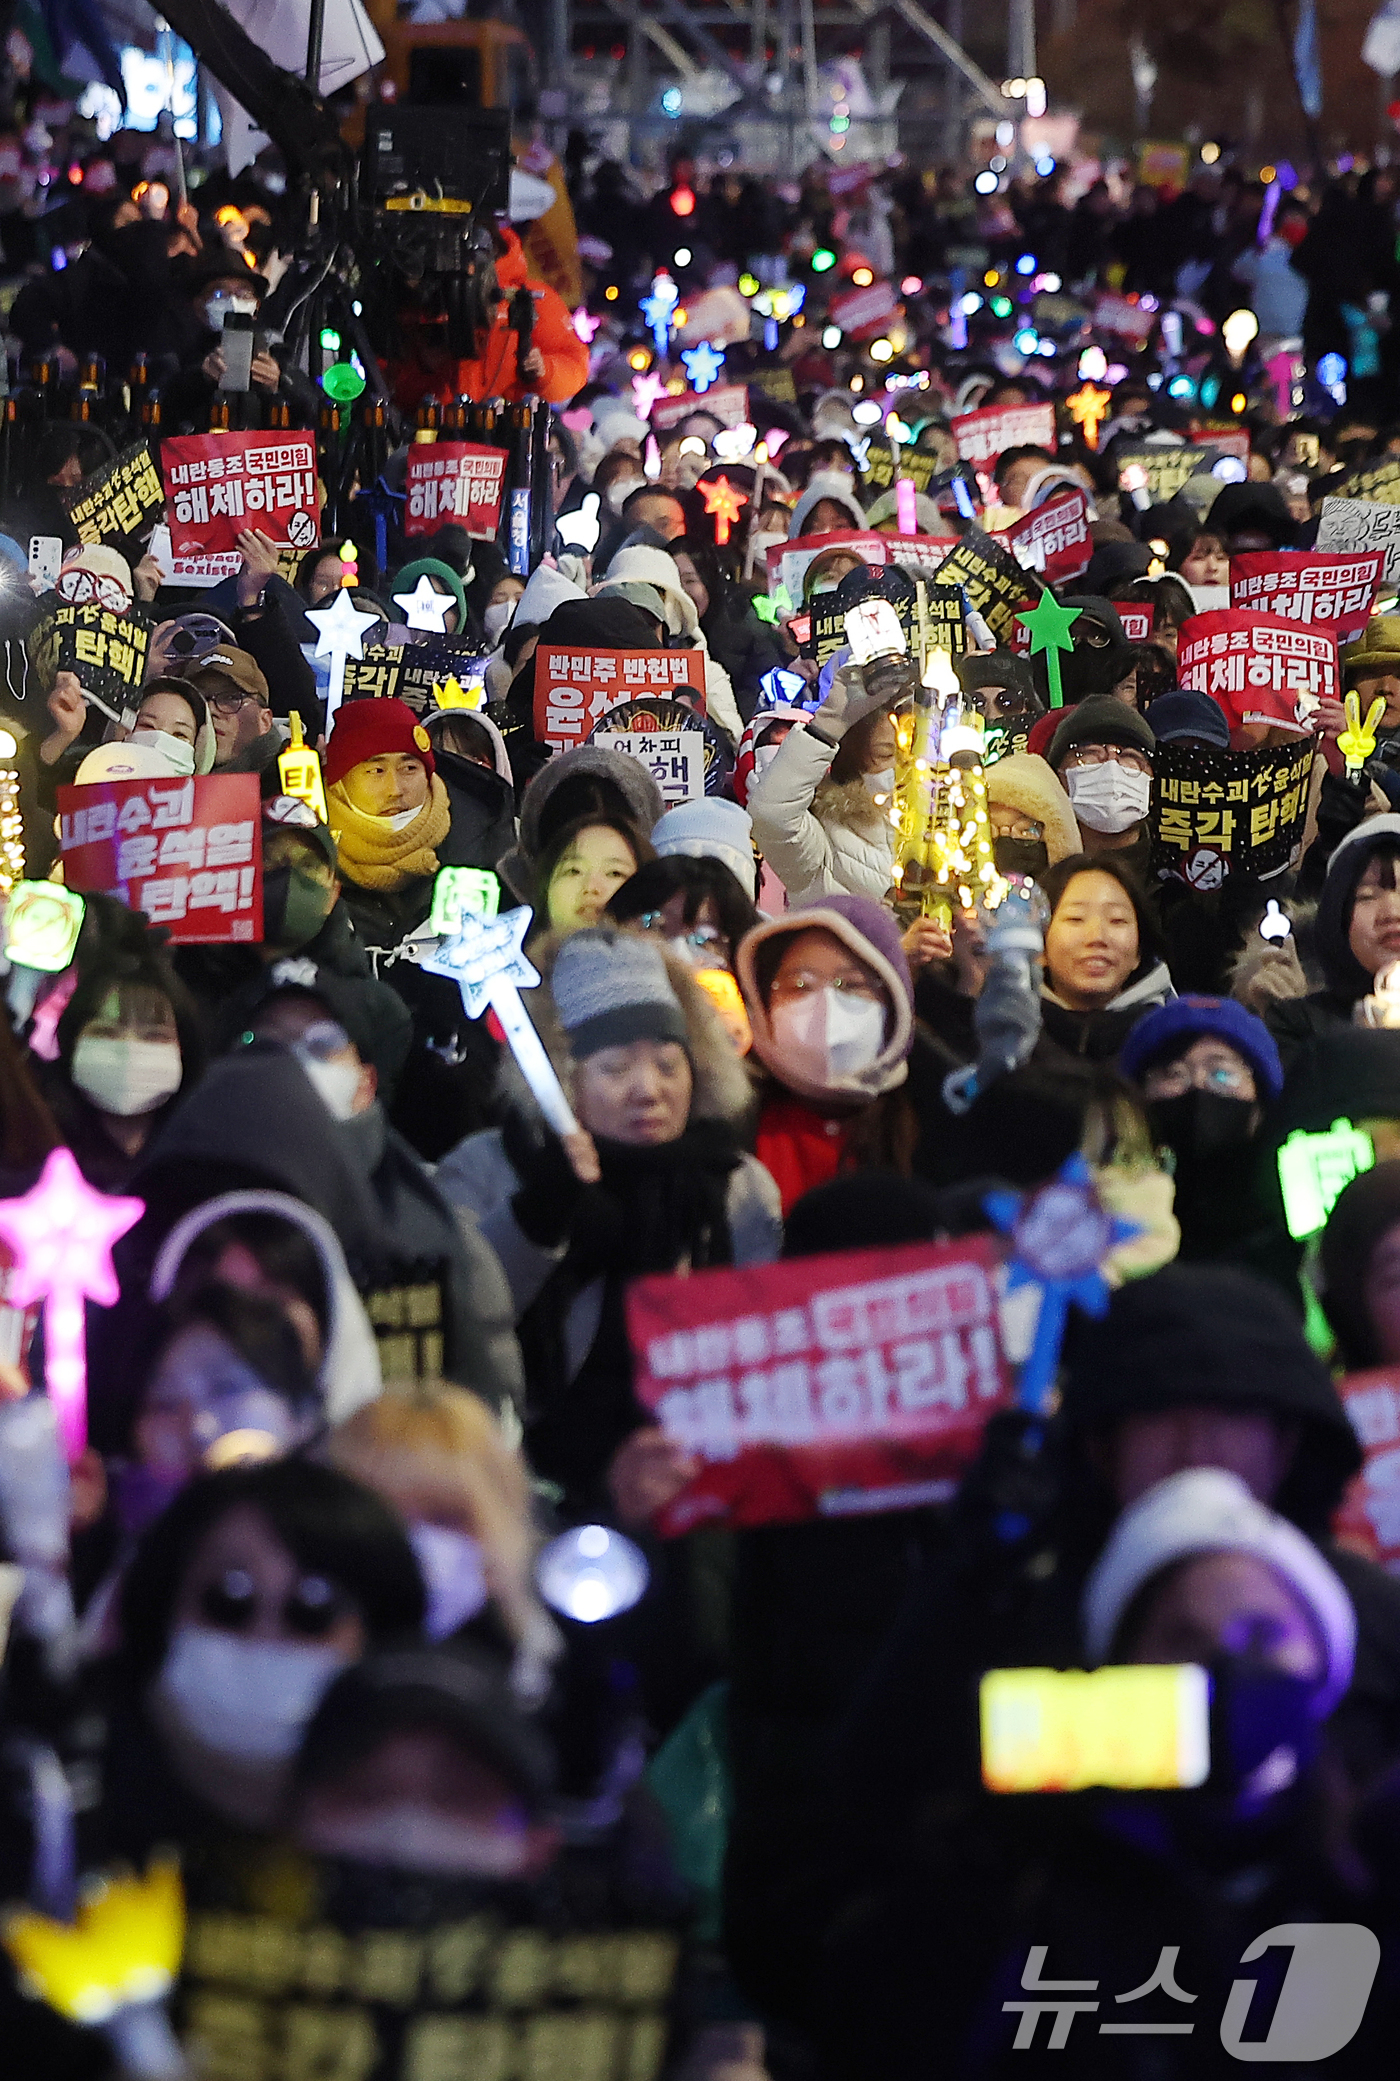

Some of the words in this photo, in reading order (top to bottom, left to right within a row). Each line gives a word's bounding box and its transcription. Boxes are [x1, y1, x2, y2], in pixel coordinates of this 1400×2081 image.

[171, 454, 244, 484] 내란동조
[249, 447, 308, 470] 국민의힘
[173, 472, 315, 524] 해체하라!
[1234, 571, 1298, 599] 내란동조
[1302, 565, 1373, 587] 국민의힘
[76, 629, 145, 688] 탄핵!
[549, 654, 617, 684] 반민주
[623, 657, 689, 684] 반헌법
[1181, 631, 1249, 667] 내란동조
[1256, 631, 1328, 657] 국민의힘
[1180, 653, 1335, 696] 해체하라!
[613, 736, 681, 753] 어차피
[1160, 777, 1249, 805] 내란수괴
[61, 776, 195, 851] 내란수괴
[1158, 807, 1237, 852] 즉각
[1250, 778, 1308, 847] 탄핵!
[116, 820, 255, 880] 윤석열
[140, 866, 256, 925] 탄핵!
